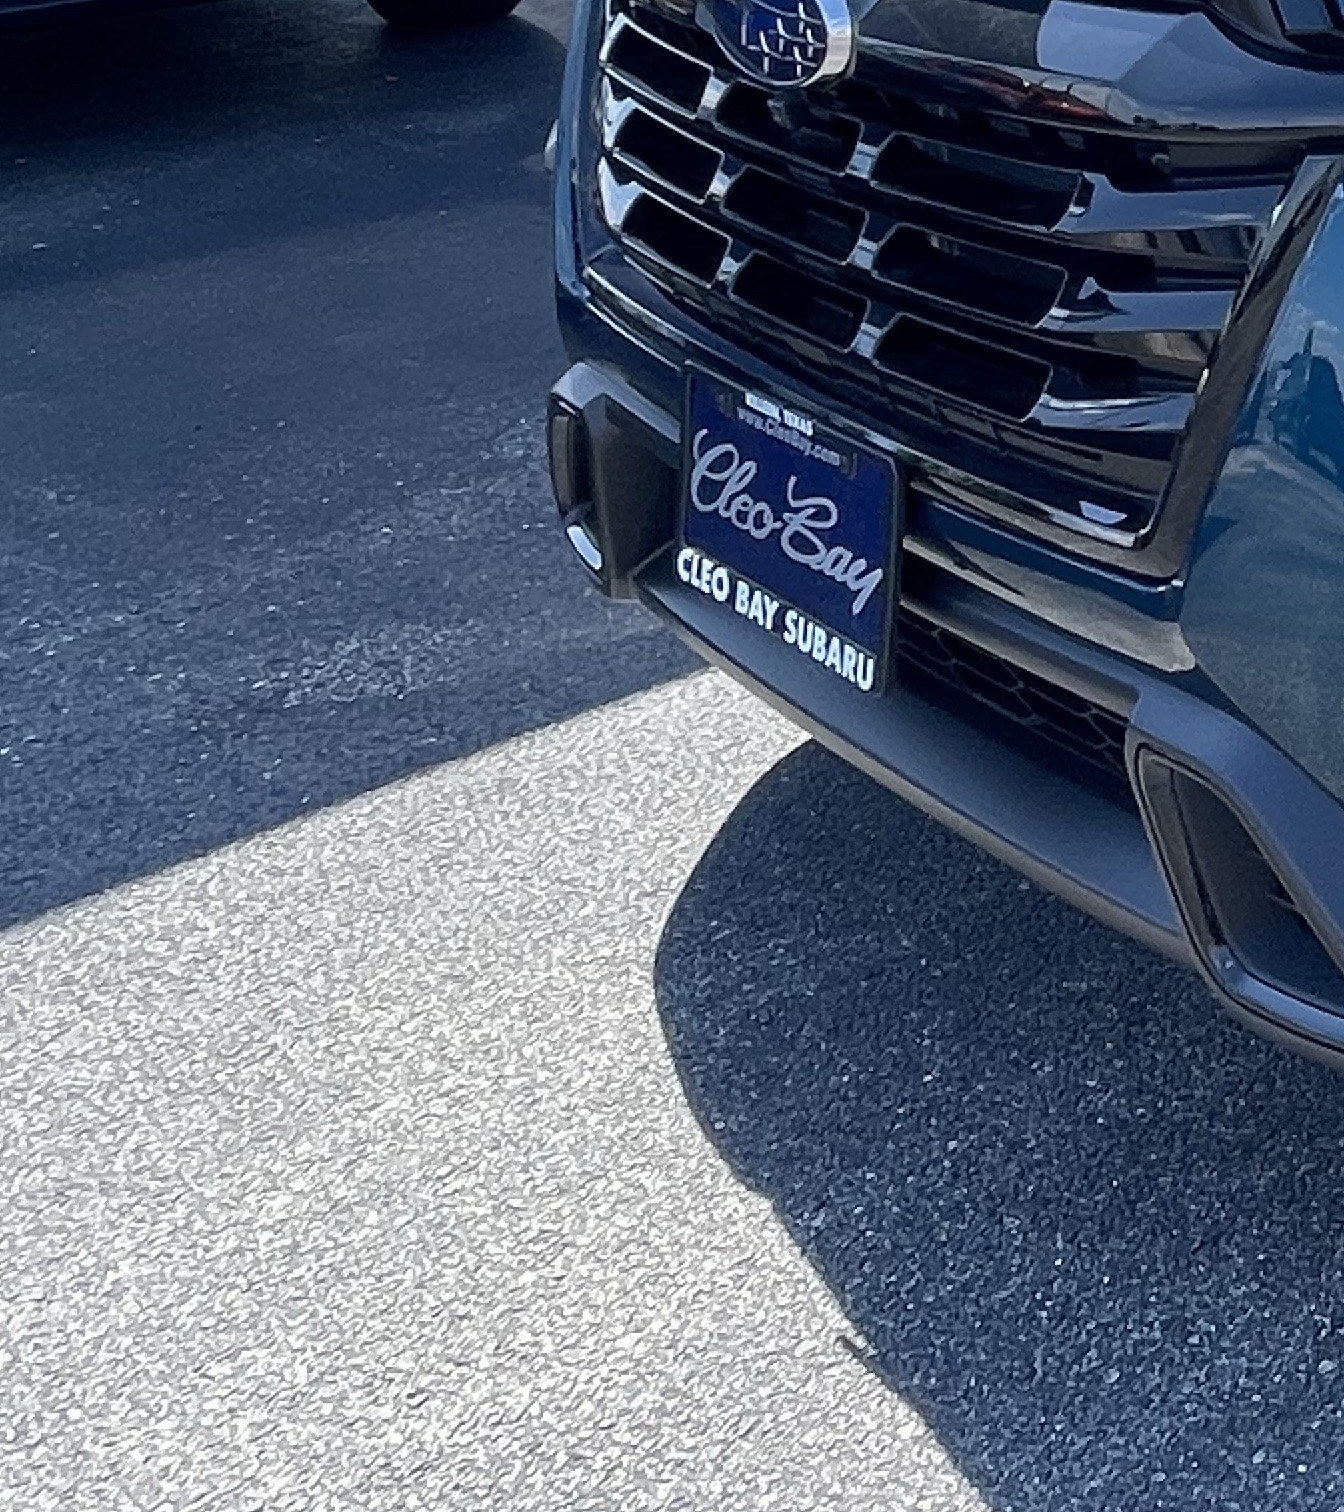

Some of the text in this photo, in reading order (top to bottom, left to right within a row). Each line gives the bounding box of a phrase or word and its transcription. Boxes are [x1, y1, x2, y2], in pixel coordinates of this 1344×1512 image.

[690, 428, 884, 616] Cleo Bay
[676, 547, 875, 691] CLEO BAY SUBARU
